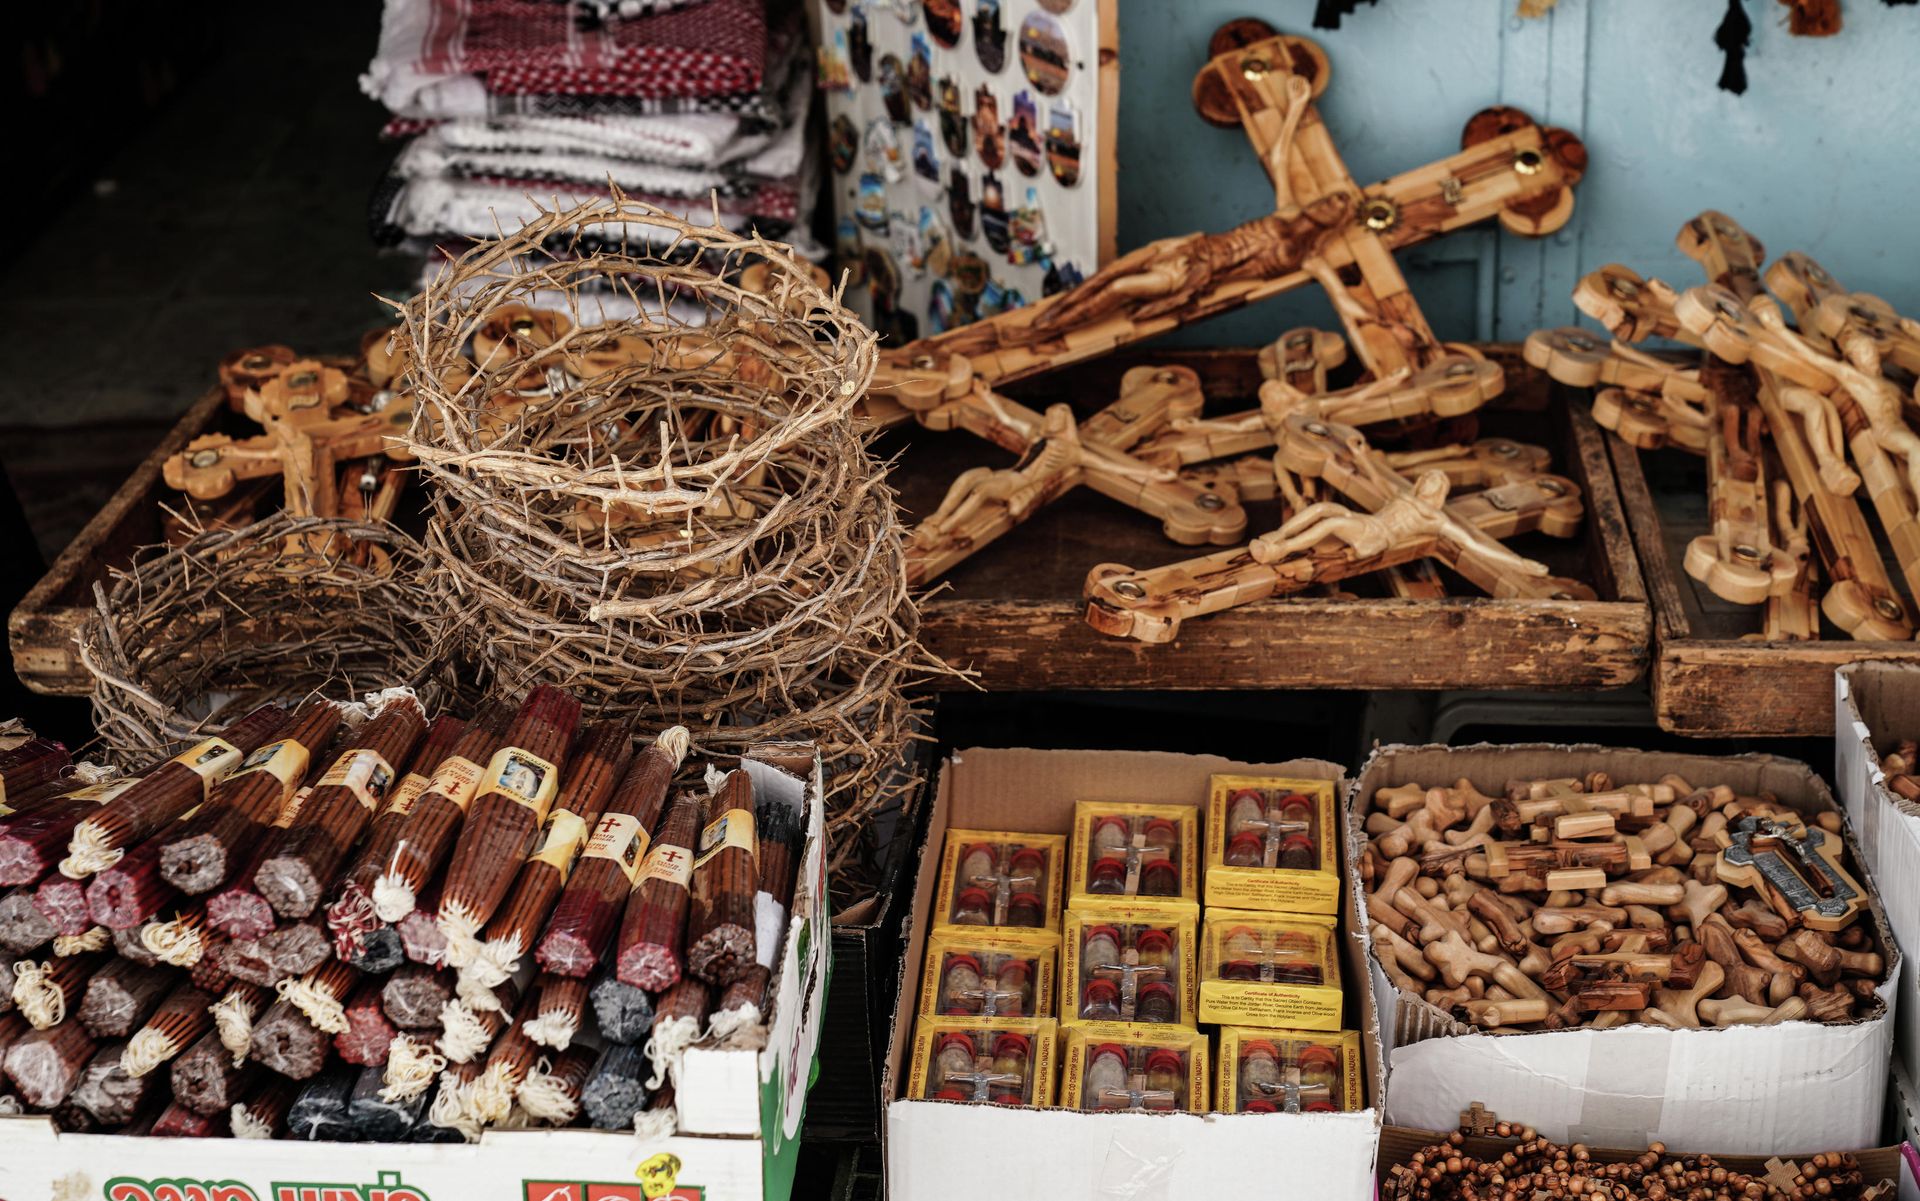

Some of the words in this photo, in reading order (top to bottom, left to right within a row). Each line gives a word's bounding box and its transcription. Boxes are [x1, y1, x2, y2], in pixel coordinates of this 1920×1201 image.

[1185, 931, 1193, 954] NAZARETH
[1186, 957, 1194, 983] BETHLEHEM
[1186, 988, 1194, 1014] JERUSALEM
[1041, 1036, 1050, 1061] NAZARETH
[1195, 1052, 1203, 1076] NAZARETH
[1039, 1066, 1047, 1095] BETHLEHEM
[1194, 1081, 1202, 1110] BETHLEHEM
